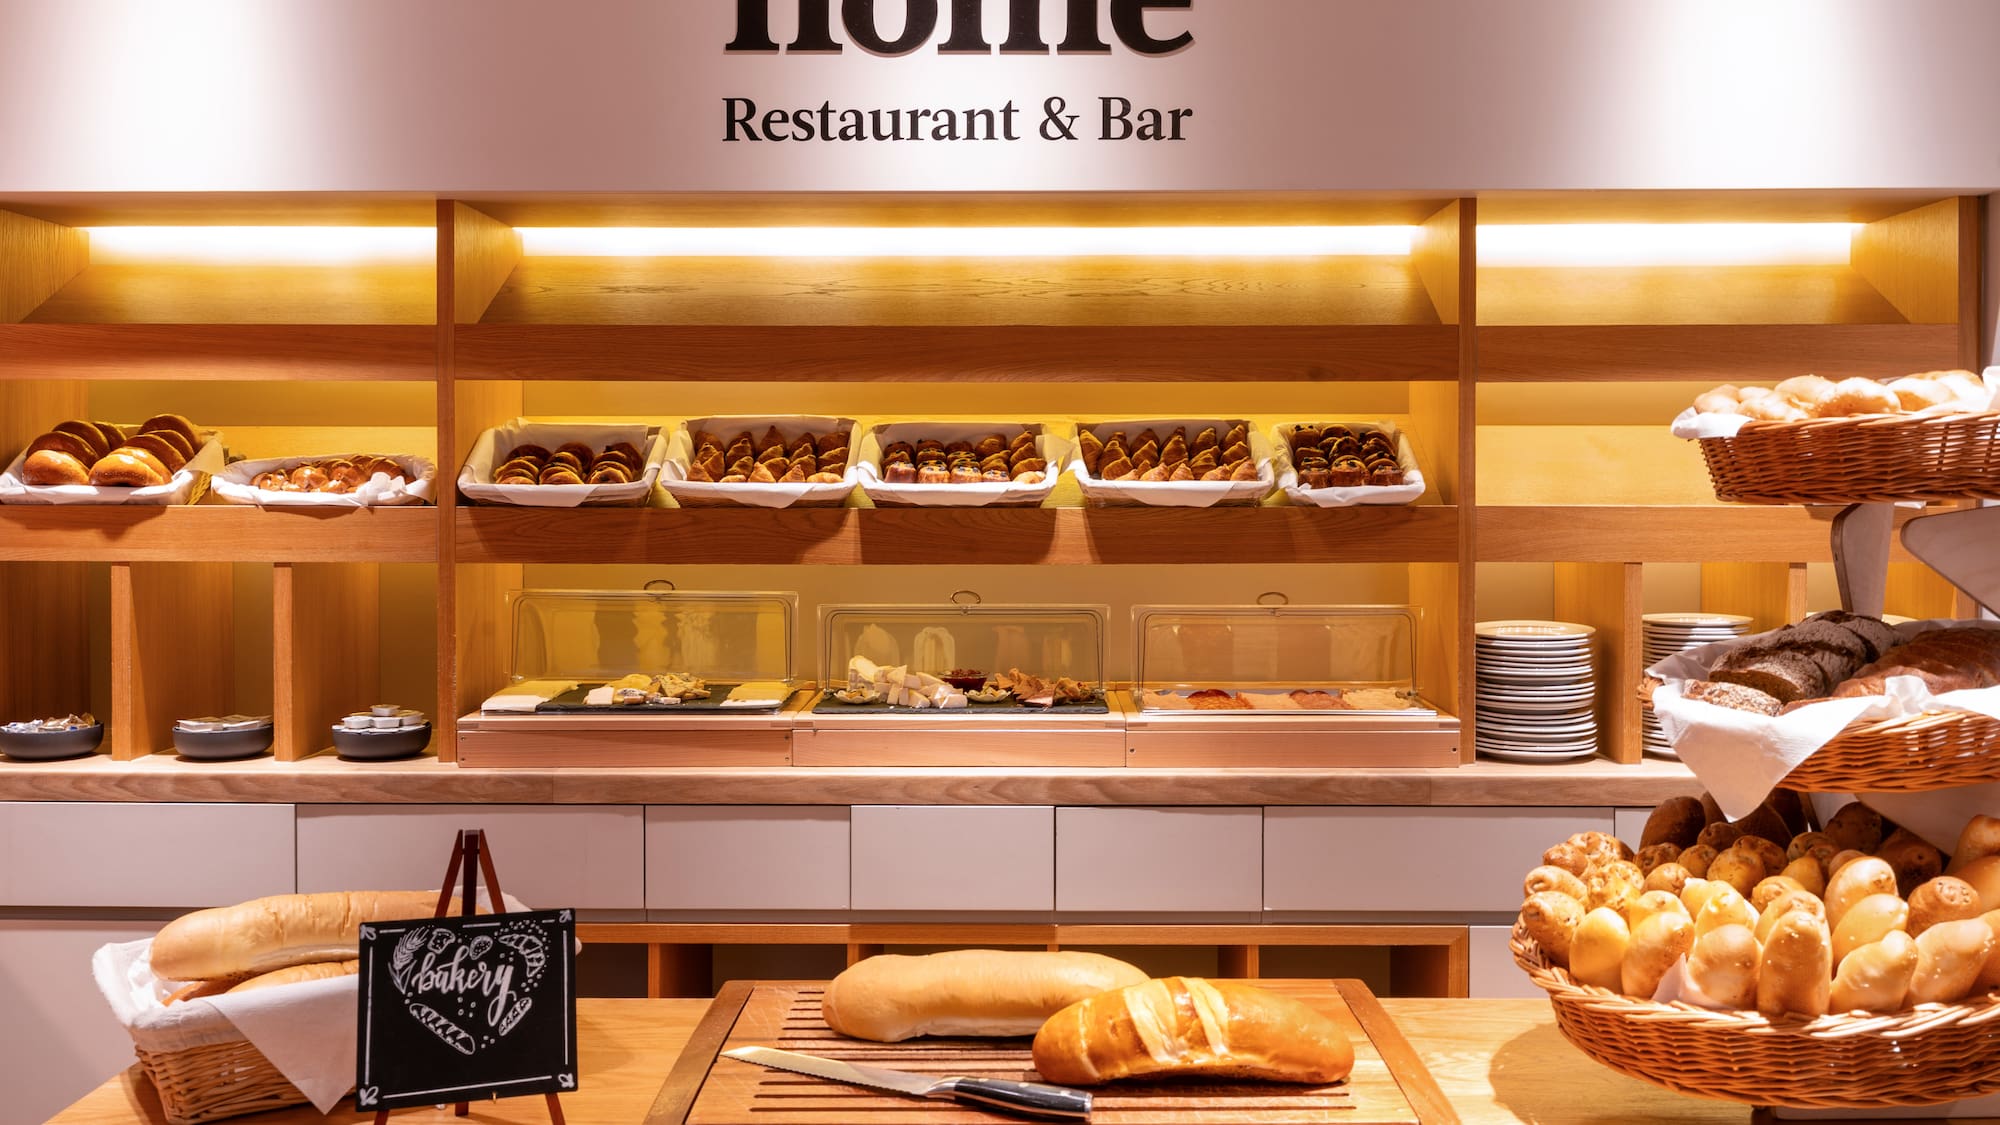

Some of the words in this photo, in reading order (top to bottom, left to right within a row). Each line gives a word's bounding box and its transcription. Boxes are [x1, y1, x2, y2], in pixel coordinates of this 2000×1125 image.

[722, 97, 1020, 142] Restaurant
[1039, 96, 1080, 141] &
[1097, 96, 1193, 141] Bar
[411, 946, 517, 1027] bakery
